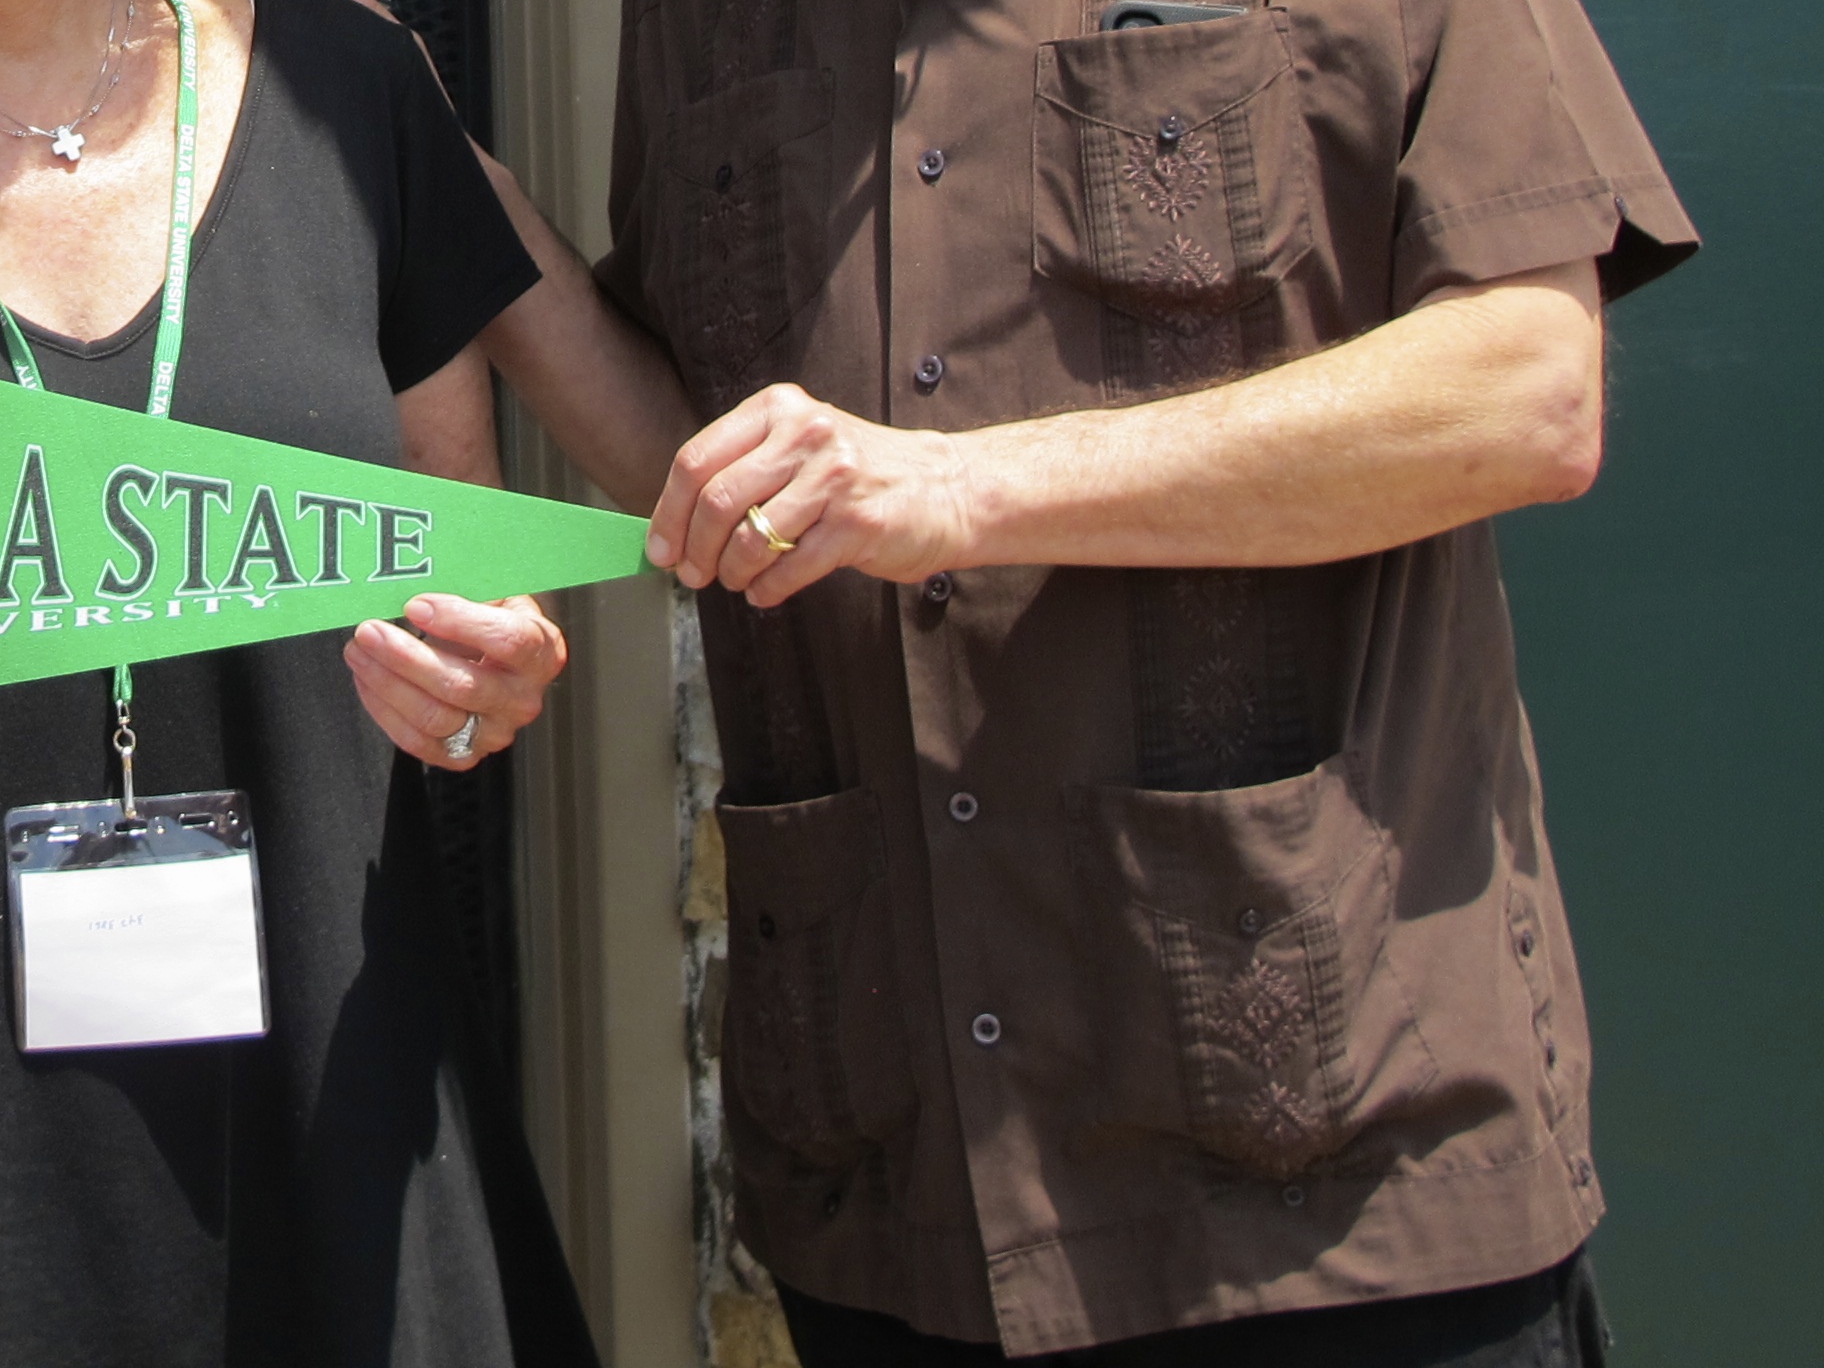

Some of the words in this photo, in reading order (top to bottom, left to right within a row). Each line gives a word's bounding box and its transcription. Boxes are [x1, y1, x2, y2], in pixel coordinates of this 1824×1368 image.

[179, 4, 196, 92] UNIVERSITY
[177, 123, 194, 172] DELTA
[174, 175, 192, 223] STATE
[165, 226, 190, 324] UNIVERSITY
[151, 360, 174, 416] DELTA
[95, 463, 433, 602] STATE
